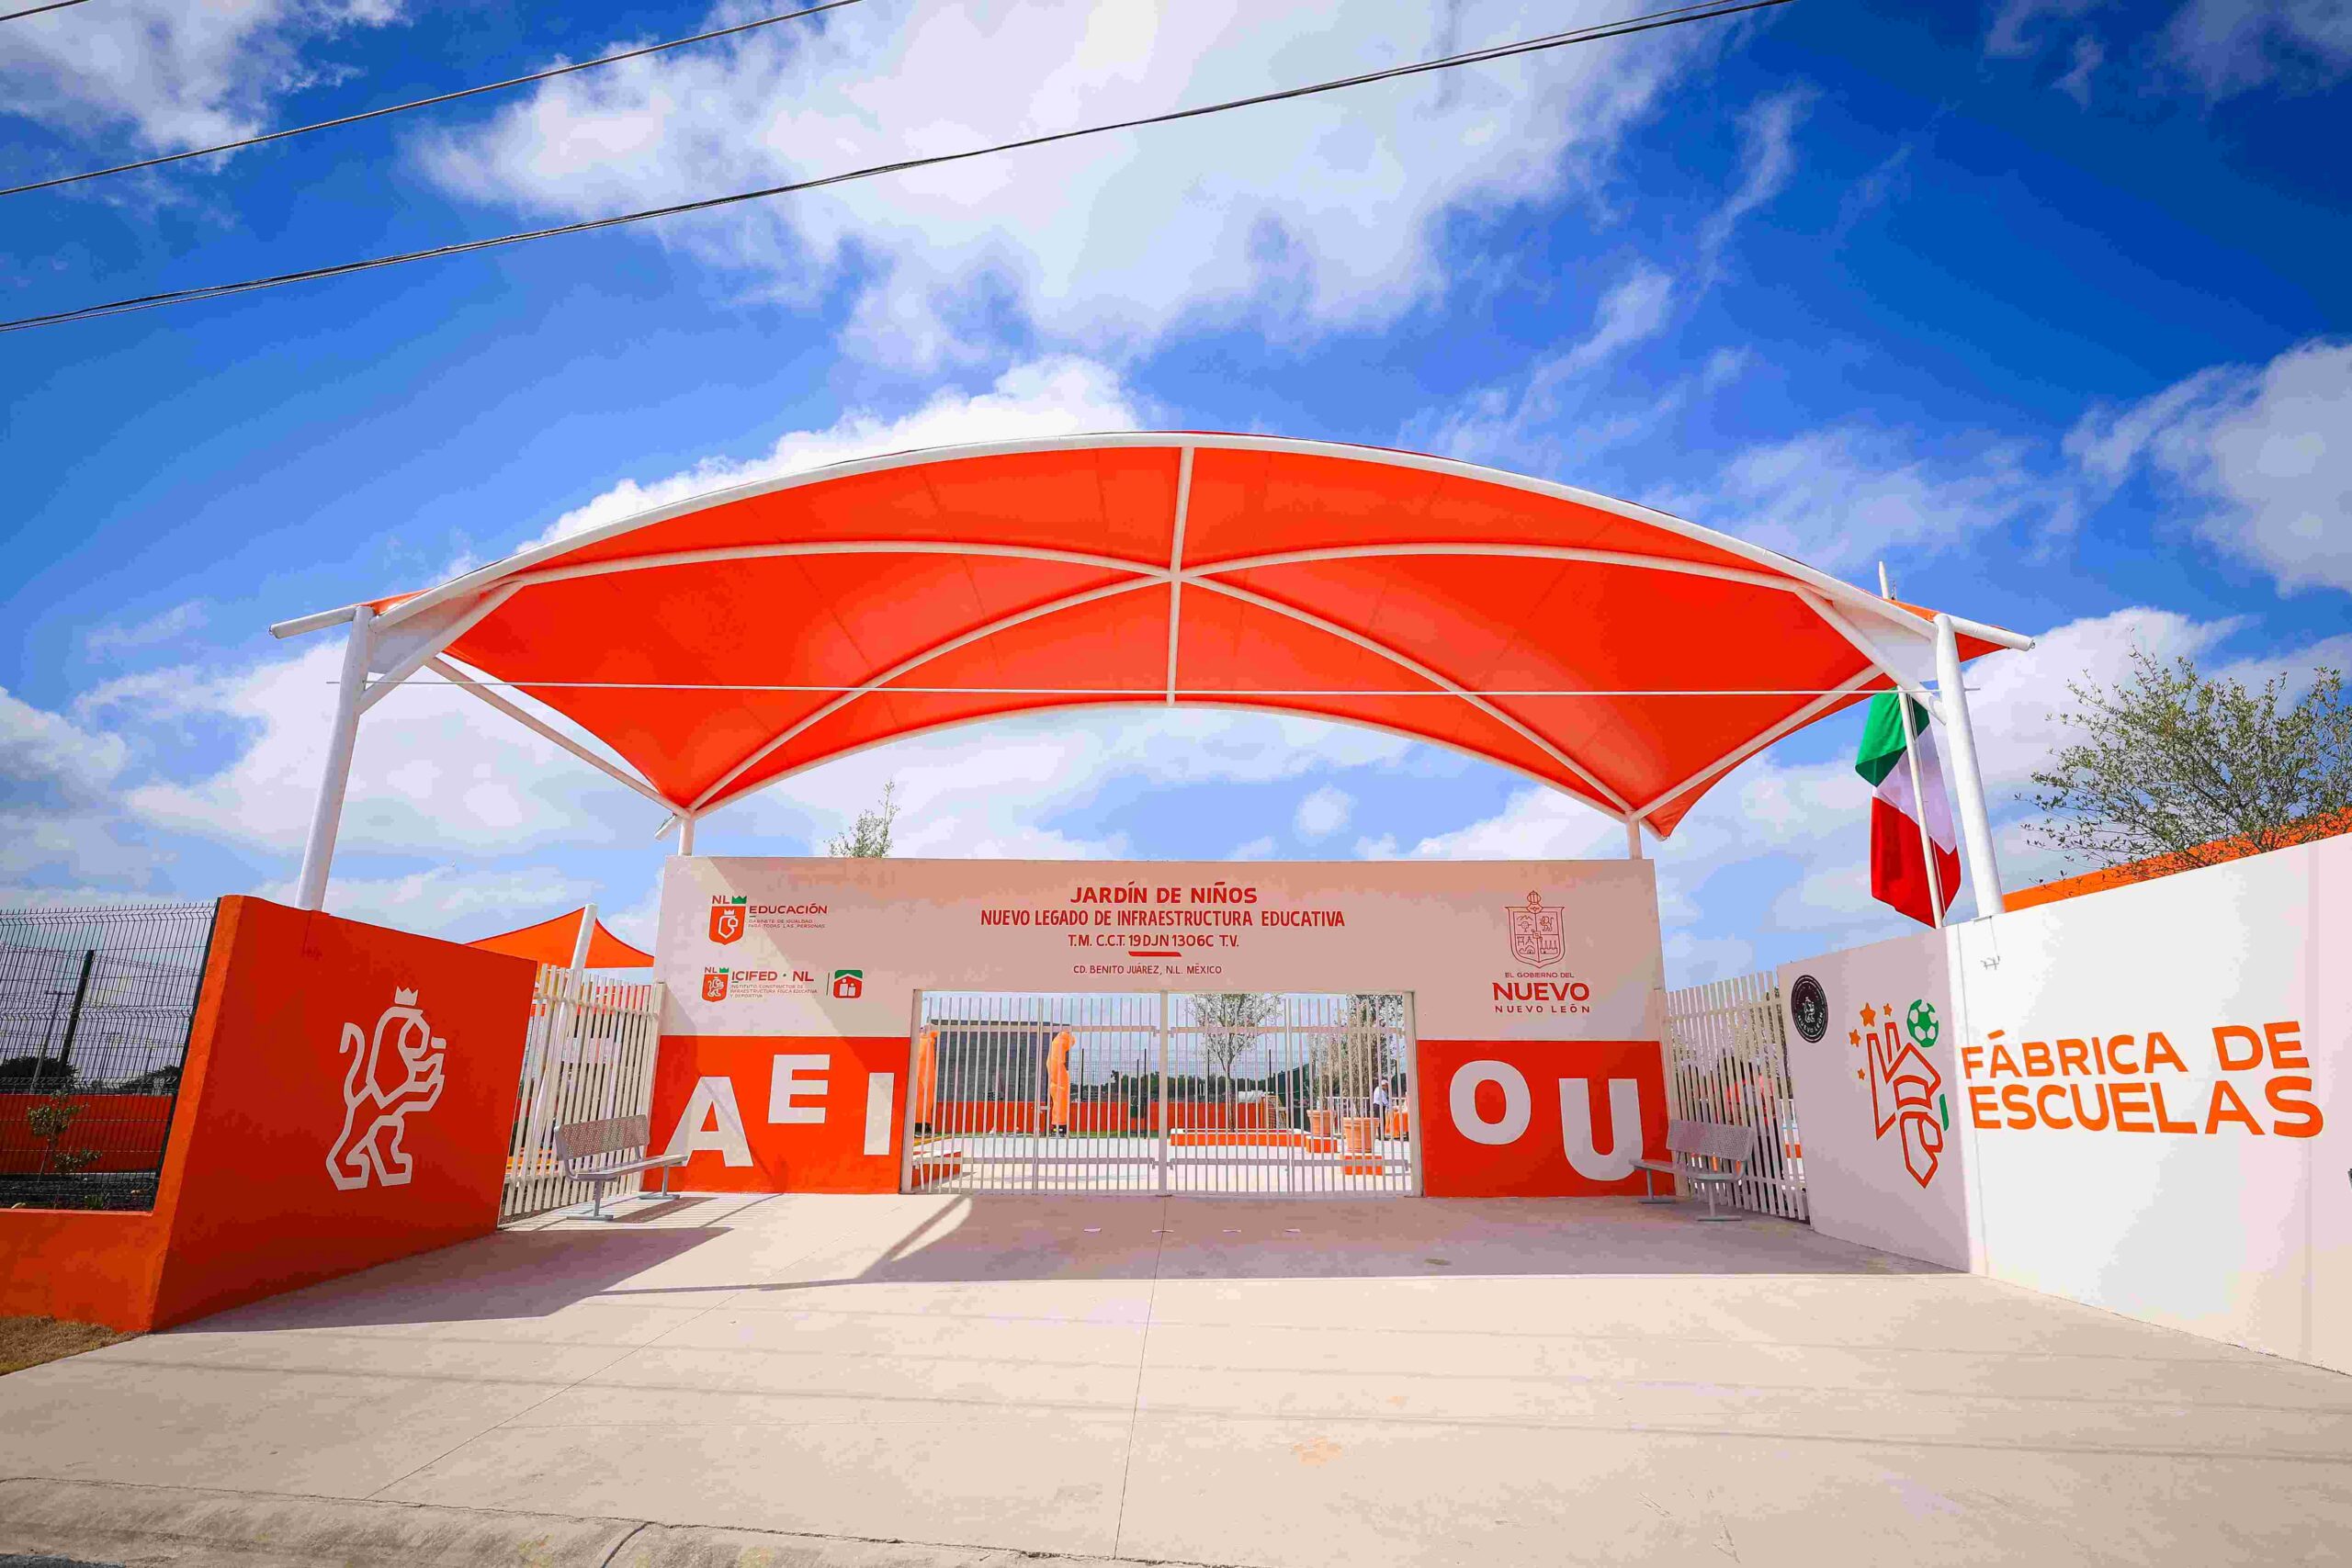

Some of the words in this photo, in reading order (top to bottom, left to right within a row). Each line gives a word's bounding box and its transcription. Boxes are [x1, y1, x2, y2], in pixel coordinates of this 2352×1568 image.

[712, 895, 730, 905] NL
[1069, 881, 1148, 904] JARDÍN
[1156, 887, 1182, 904] DE
[1191, 881, 1258, 904] NIÑOS
[749, 903, 828, 914] EDUCACIÓN
[980, 909, 1031, 926] NUEVO
[1035, 909, 1089, 926] LEGADO
[1094, 910, 1112, 926] DE
[1117, 910, 1253, 927] INFRAESTRUCTURA
[1261, 910, 1346, 927] EDUCATIVA
[1068, 934, 1092, 947] T.M.
[1096, 934, 1125, 947] C.C.T.
[1219, 934, 1239, 947] T.V.
[731, 971, 778, 981] ICIFED
[792, 971, 815, 982] NL
[1073, 965, 1088, 974] CD.
[1090, 965, 1125, 974] BENITO
[1126, 963, 1162, 976] JUÁREZ,
[1166, 965, 1183, 975] N.L.
[1186, 964, 1222, 975] MÉXICO
[1492, 983, 1590, 1001] NUEVO
[1551, 1004, 1590, 1013] LEÓN
[1961, 1030, 2188, 1079] FÁBRICA
[2212, 1021, 2310, 1071] DE
[663, 1077, 754, 1168] A
[768, 1055, 831, 1123] E
[864, 1072, 895, 1156] I
[1968, 1076, 2324, 1138] ESCUELAS
[1449, 1060, 1532, 1145] O
[1558, 1078, 1644, 1181] U
